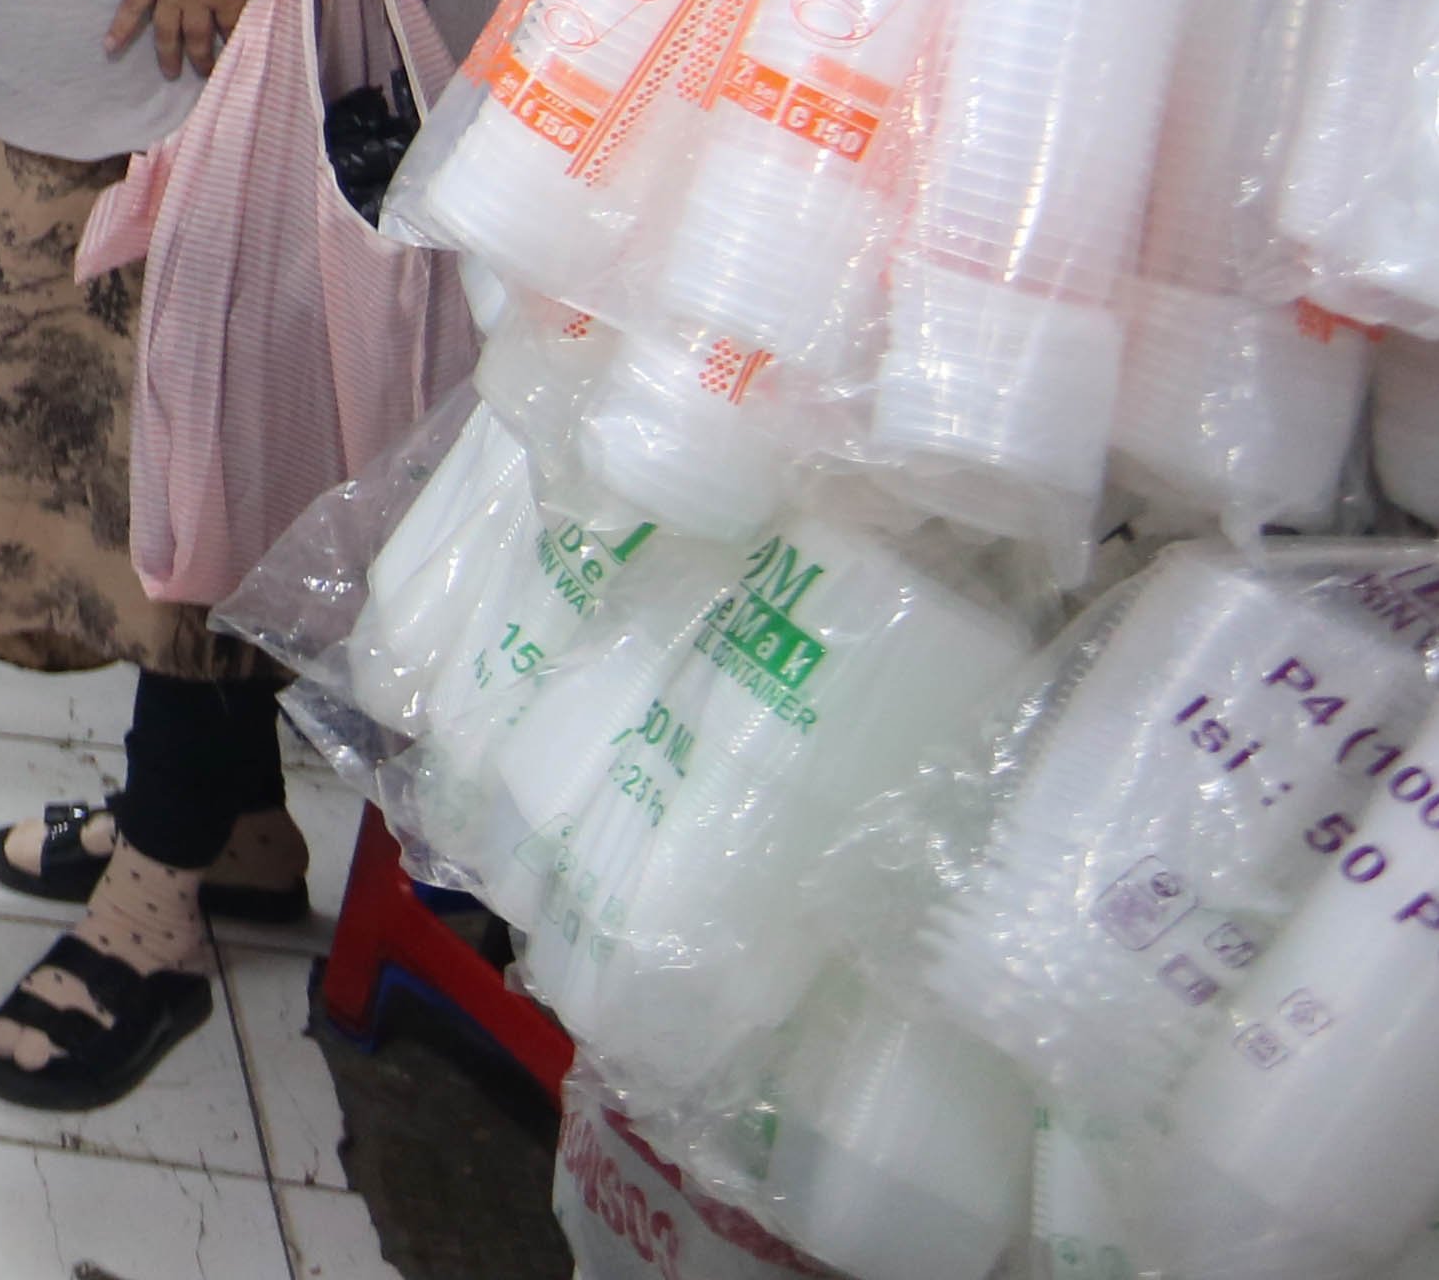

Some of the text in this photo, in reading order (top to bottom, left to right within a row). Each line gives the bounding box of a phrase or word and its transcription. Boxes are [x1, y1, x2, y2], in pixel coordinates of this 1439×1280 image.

[1261, 655, 1347, 729] P4
[1175, 693, 1263, 773] Isi
[1303, 812, 1388, 885] 50
